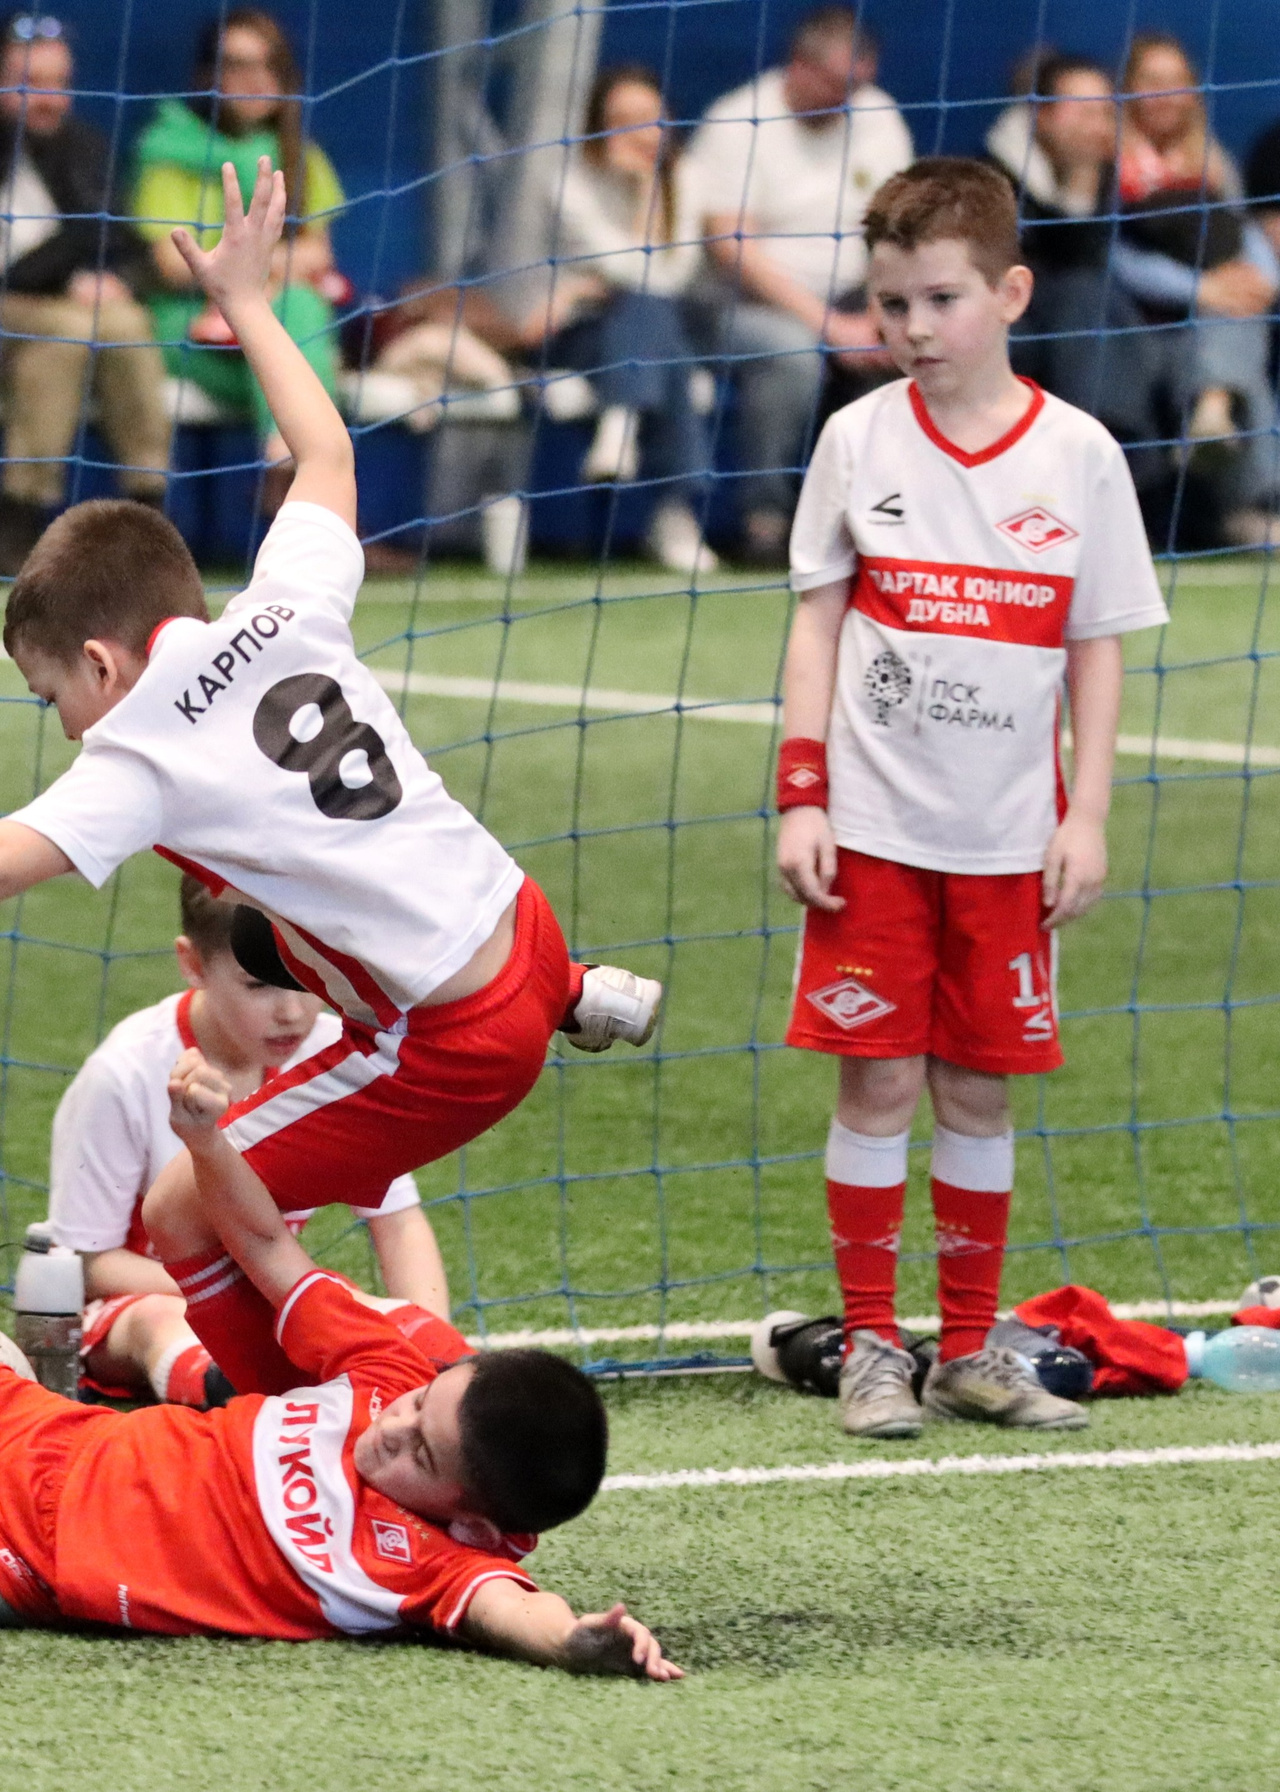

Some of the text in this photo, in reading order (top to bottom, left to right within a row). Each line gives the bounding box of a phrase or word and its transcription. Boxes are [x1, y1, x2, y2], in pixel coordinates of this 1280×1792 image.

[964, 577, 1056, 608] ЮНИОР
[905, 599, 990, 627] ДУБНА
[174, 604, 295, 724] КАРПОВ
[931, 679, 981, 704] ПСК
[928, 704, 1016, 732] ФАРМА
[252, 672, 403, 821] 8
[278, 1402, 335, 1574] ЛУКОЙЛ
